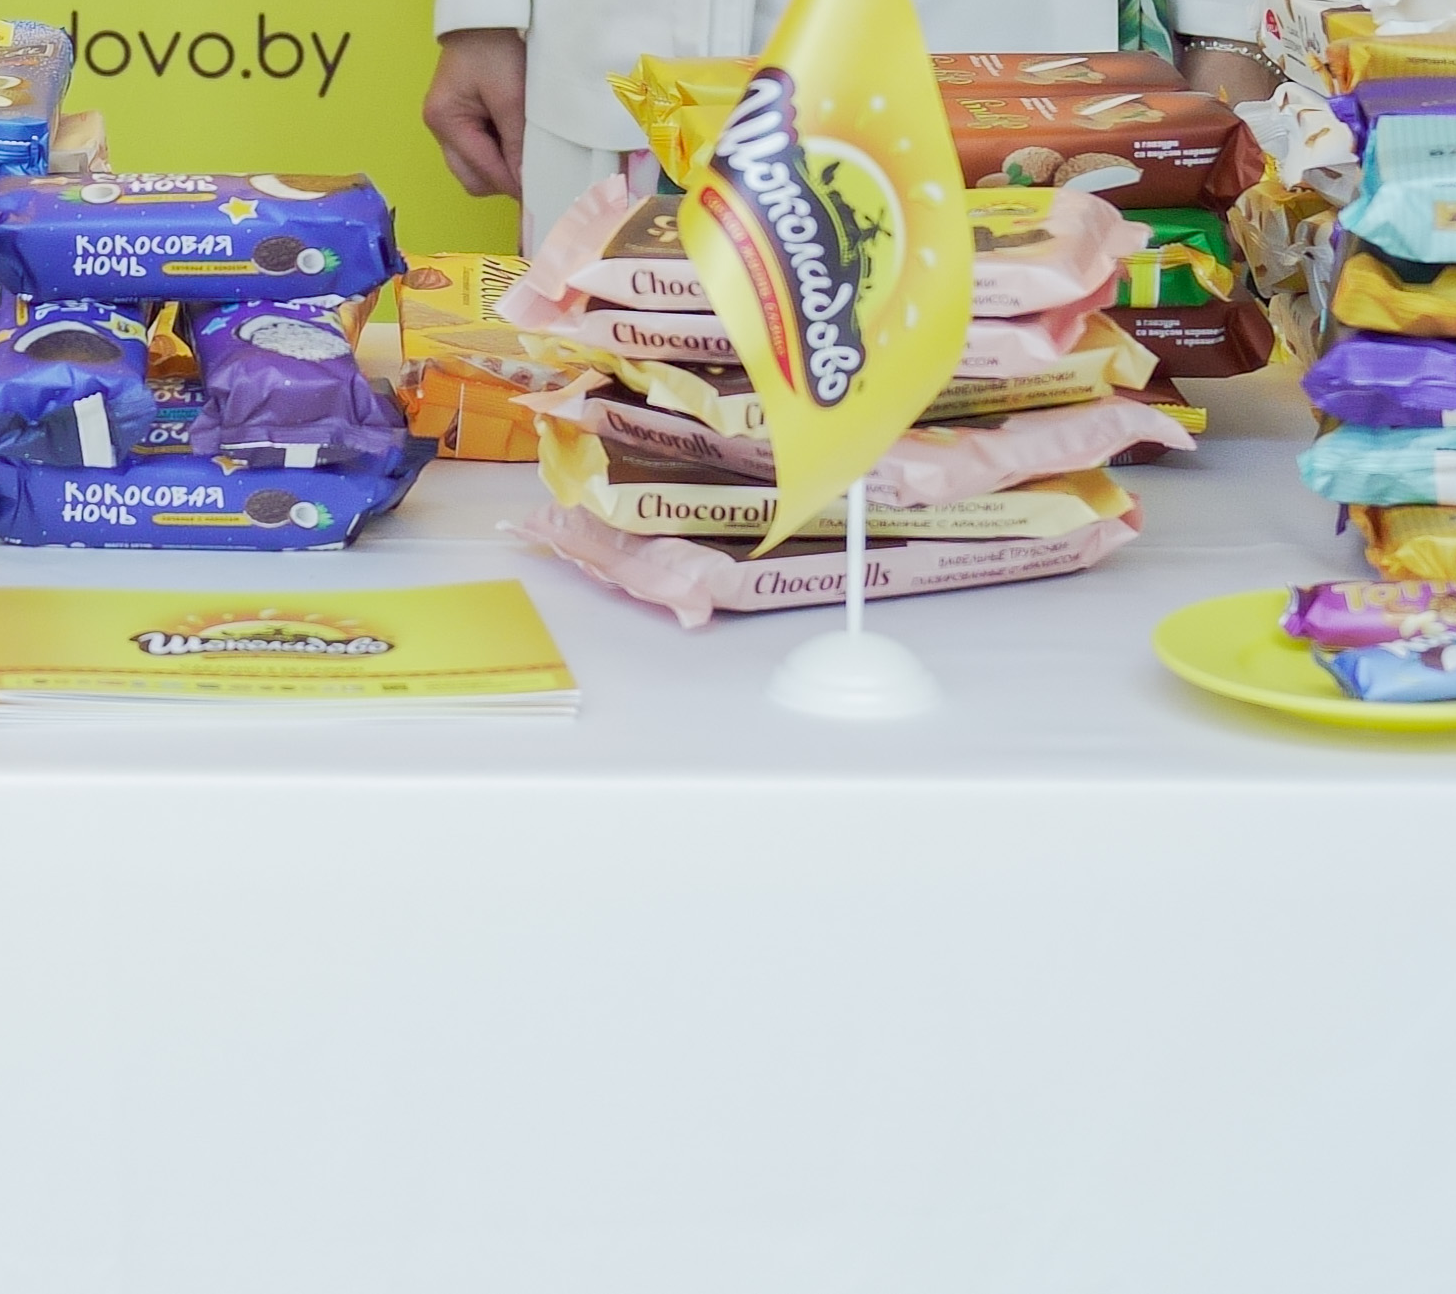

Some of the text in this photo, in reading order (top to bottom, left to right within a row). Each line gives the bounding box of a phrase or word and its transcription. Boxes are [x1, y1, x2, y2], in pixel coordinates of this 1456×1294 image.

[75, 234, 234, 256] КОКОСОВАЯ
[716, 78, 860, 401] Шоколадово
[72, 256, 148, 277] НОЧЬ
[606, 409, 722, 459] Chocorolls
[63, 481, 225, 508] КОКОСОВАЯ
[62, 504, 138, 525] НОЧЬ
[754, 563, 891, 596] Chocorlls
[137, 630, 391, 656] Шоколадово
